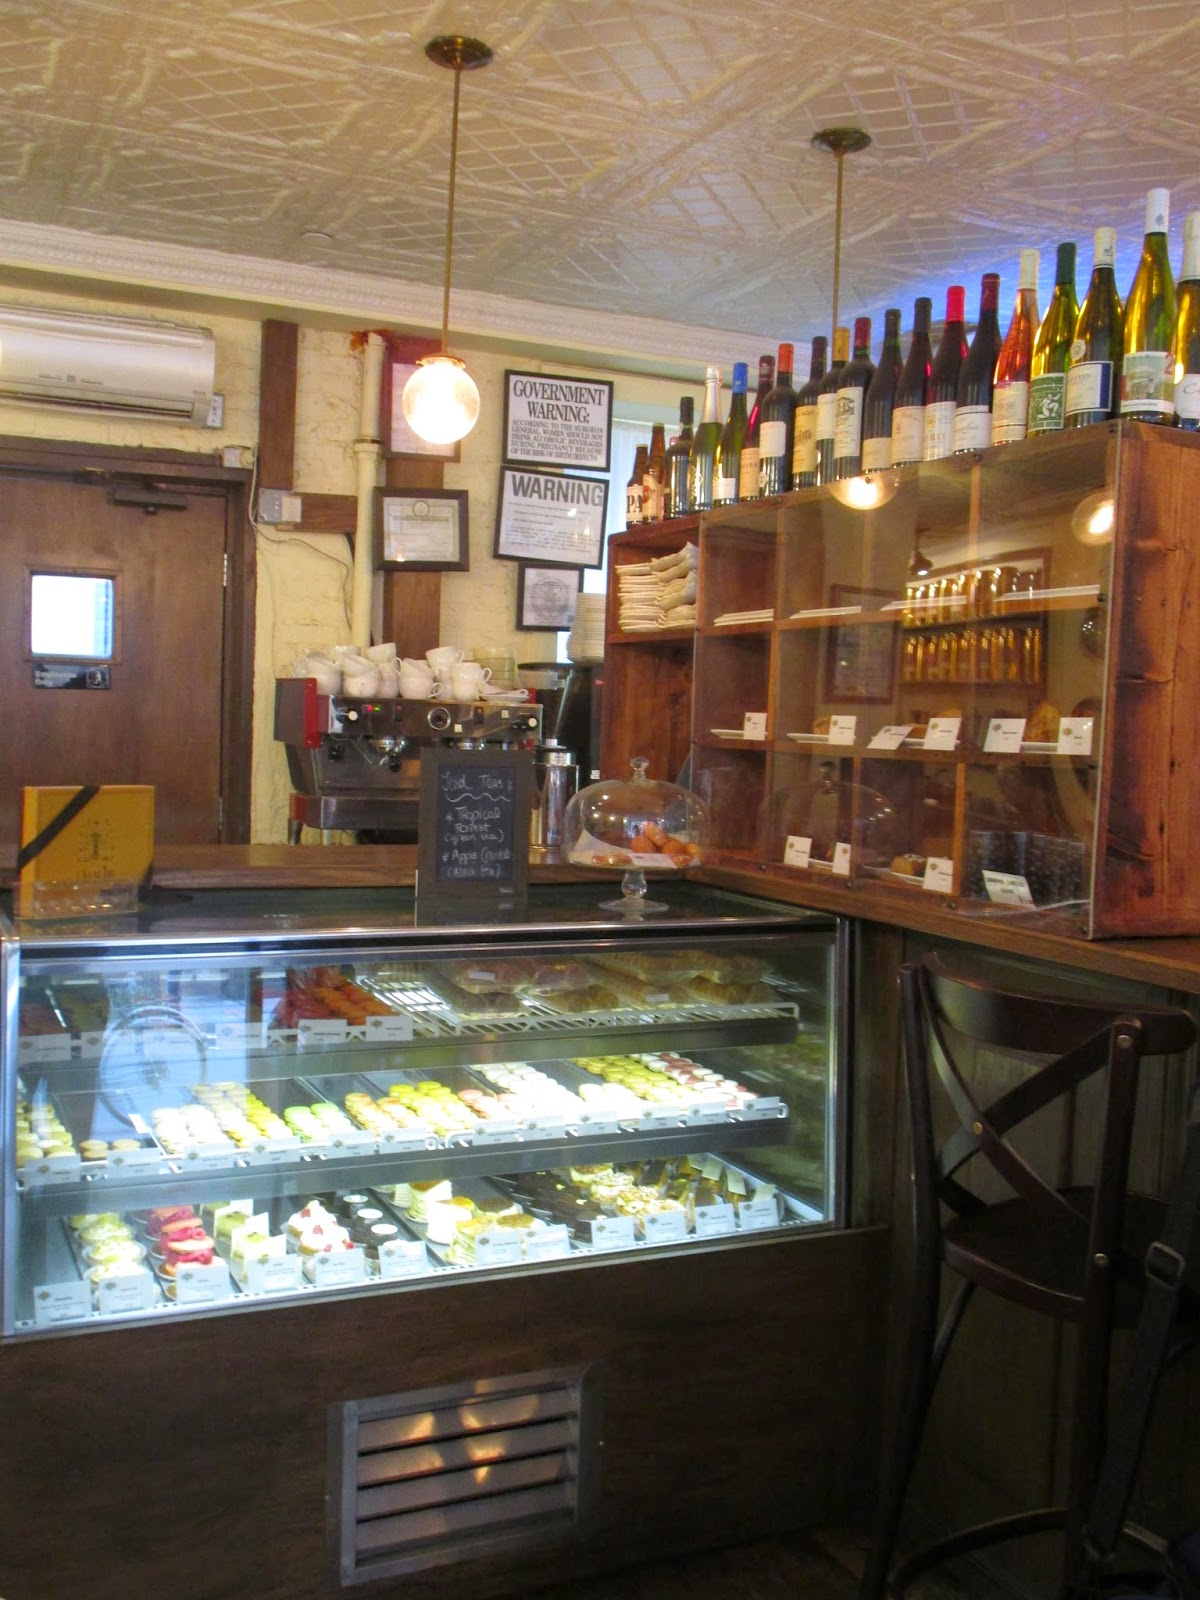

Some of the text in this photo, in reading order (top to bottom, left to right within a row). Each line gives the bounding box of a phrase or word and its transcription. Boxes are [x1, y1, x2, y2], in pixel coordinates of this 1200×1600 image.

[513, 380, 605, 406] GOVERNMENT
[527, 401, 590, 423] WARNING:
[512, 419, 549, 428] ACCORDING
[560, 423, 572, 431] THE
[574, 425, 604, 433] SURGEON
[511, 432, 603, 448] DRINK ALCOHOLIC BEVERAGES
[543, 429, 565, 437] WOMEN
[566, 431, 590, 440] SHOULD
[510, 447, 519, 455] OF
[520, 448, 531, 456] THE
[532, 449, 545, 457] RISK
[555, 451, 571, 459] BIRTH
[511, 439, 602, 455] DURING PREGNANCY BECAUSE
[511, 474, 604, 507] WARNING
